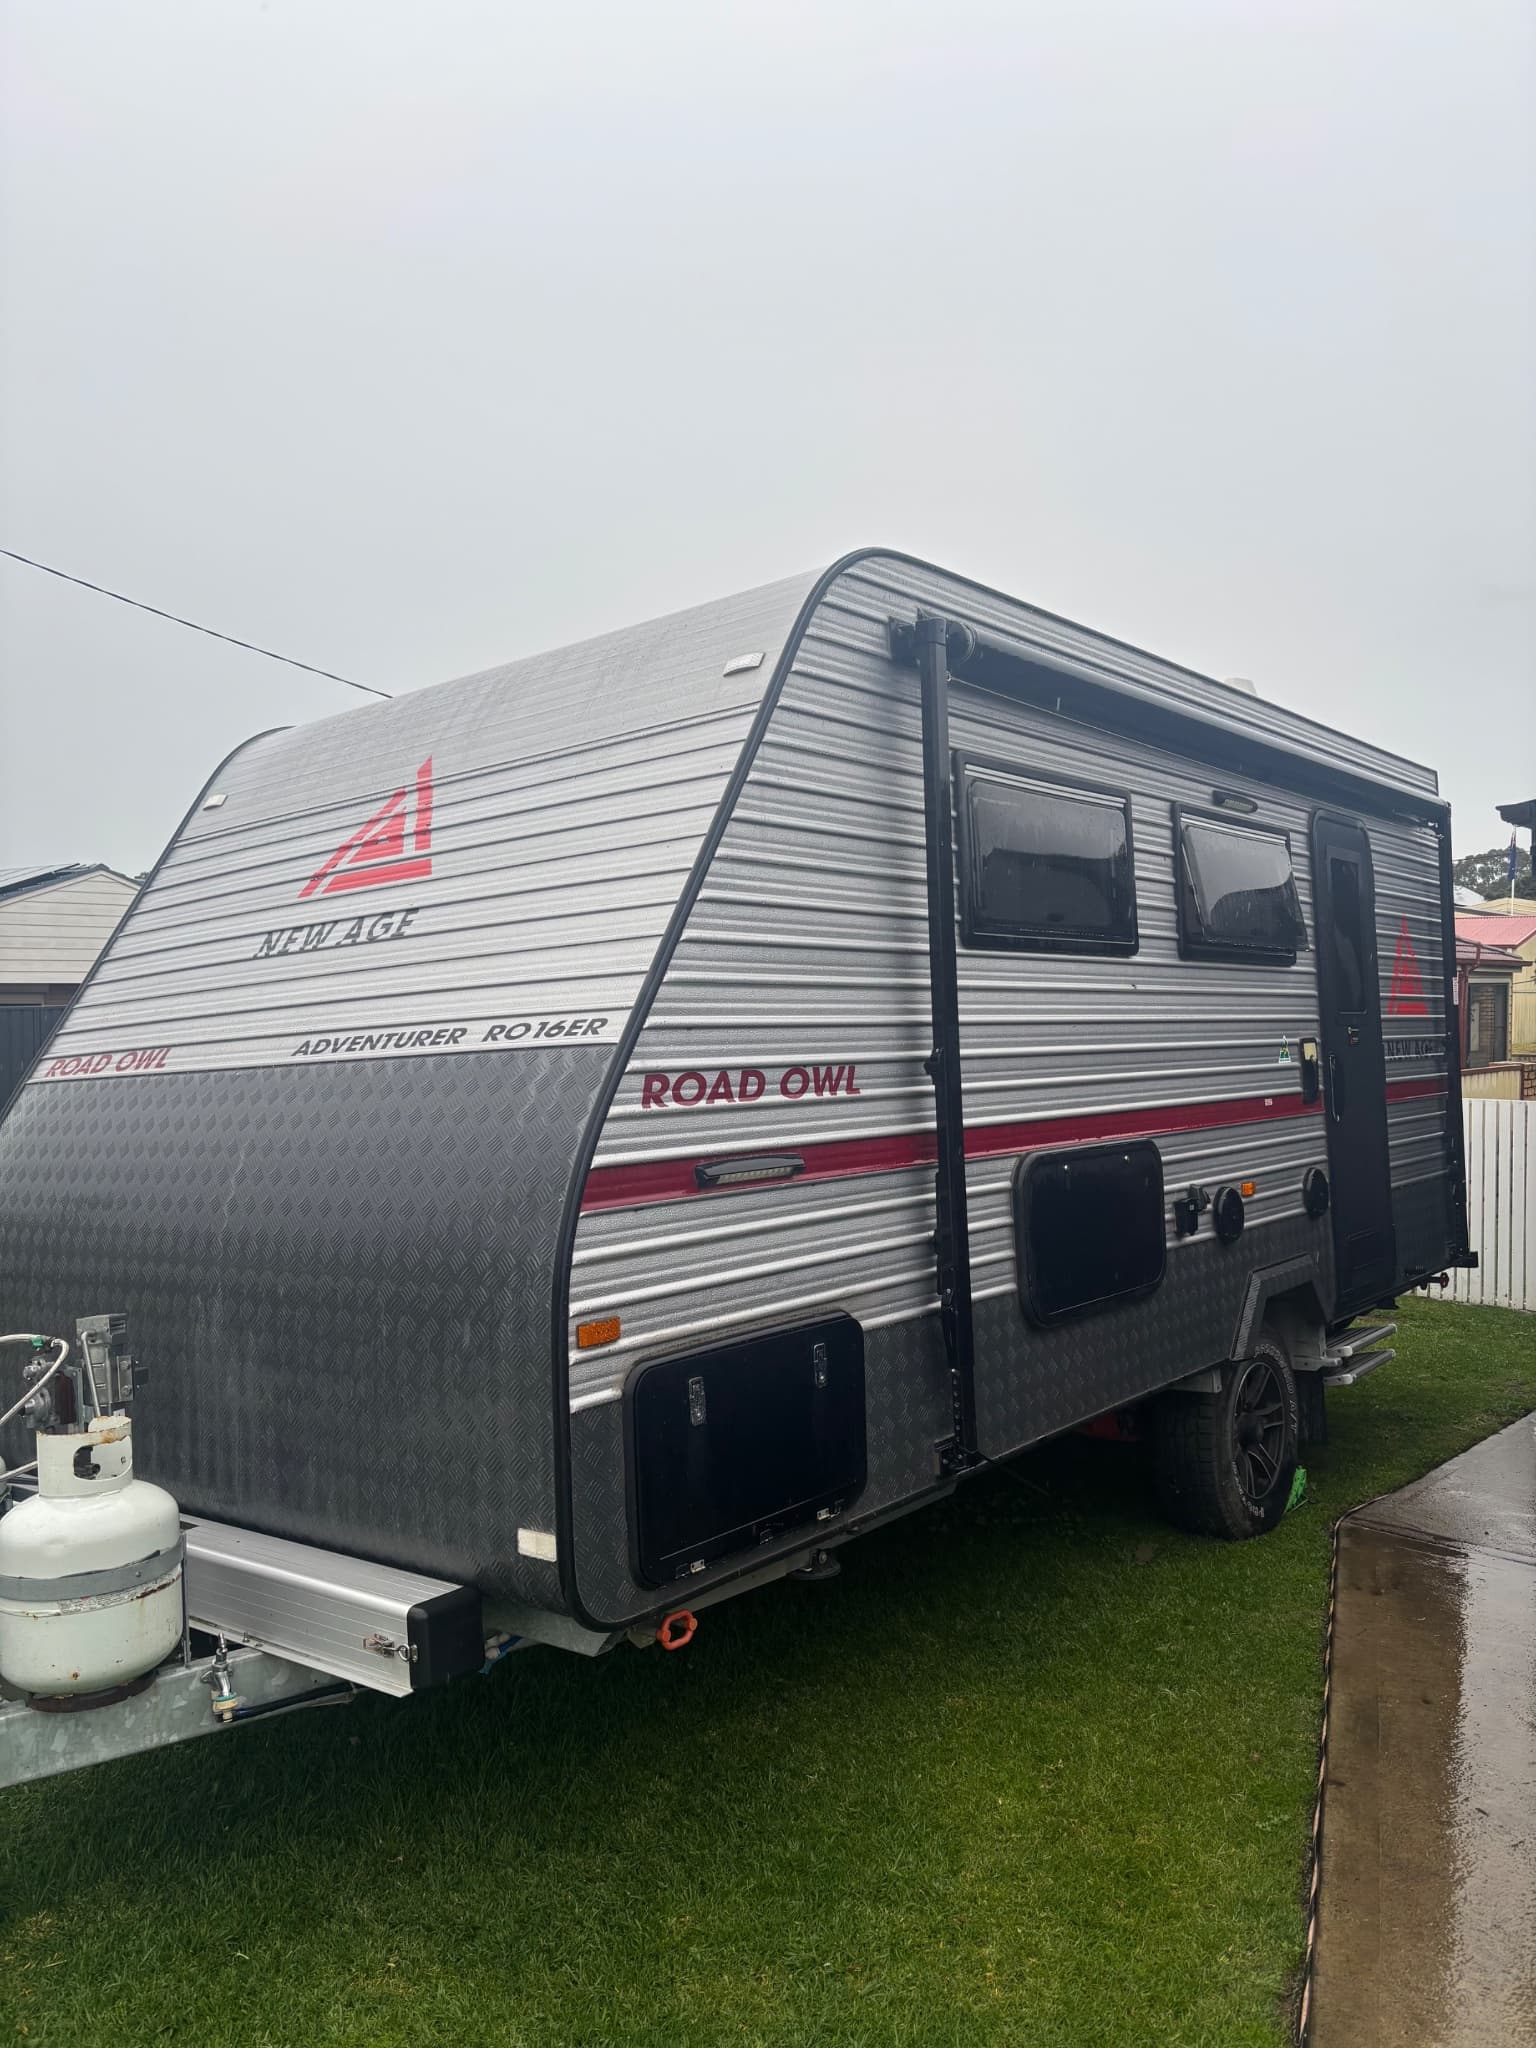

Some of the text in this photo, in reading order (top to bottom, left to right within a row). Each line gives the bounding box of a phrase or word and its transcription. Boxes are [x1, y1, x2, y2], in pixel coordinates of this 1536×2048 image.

[252, 907, 419, 958] NEW AGE
[291, 1027, 468, 1057] ADVENTURER
[44, 1047, 171, 1078] ROAD OWL
[641, 1064, 861, 1109] ROAD OWL
